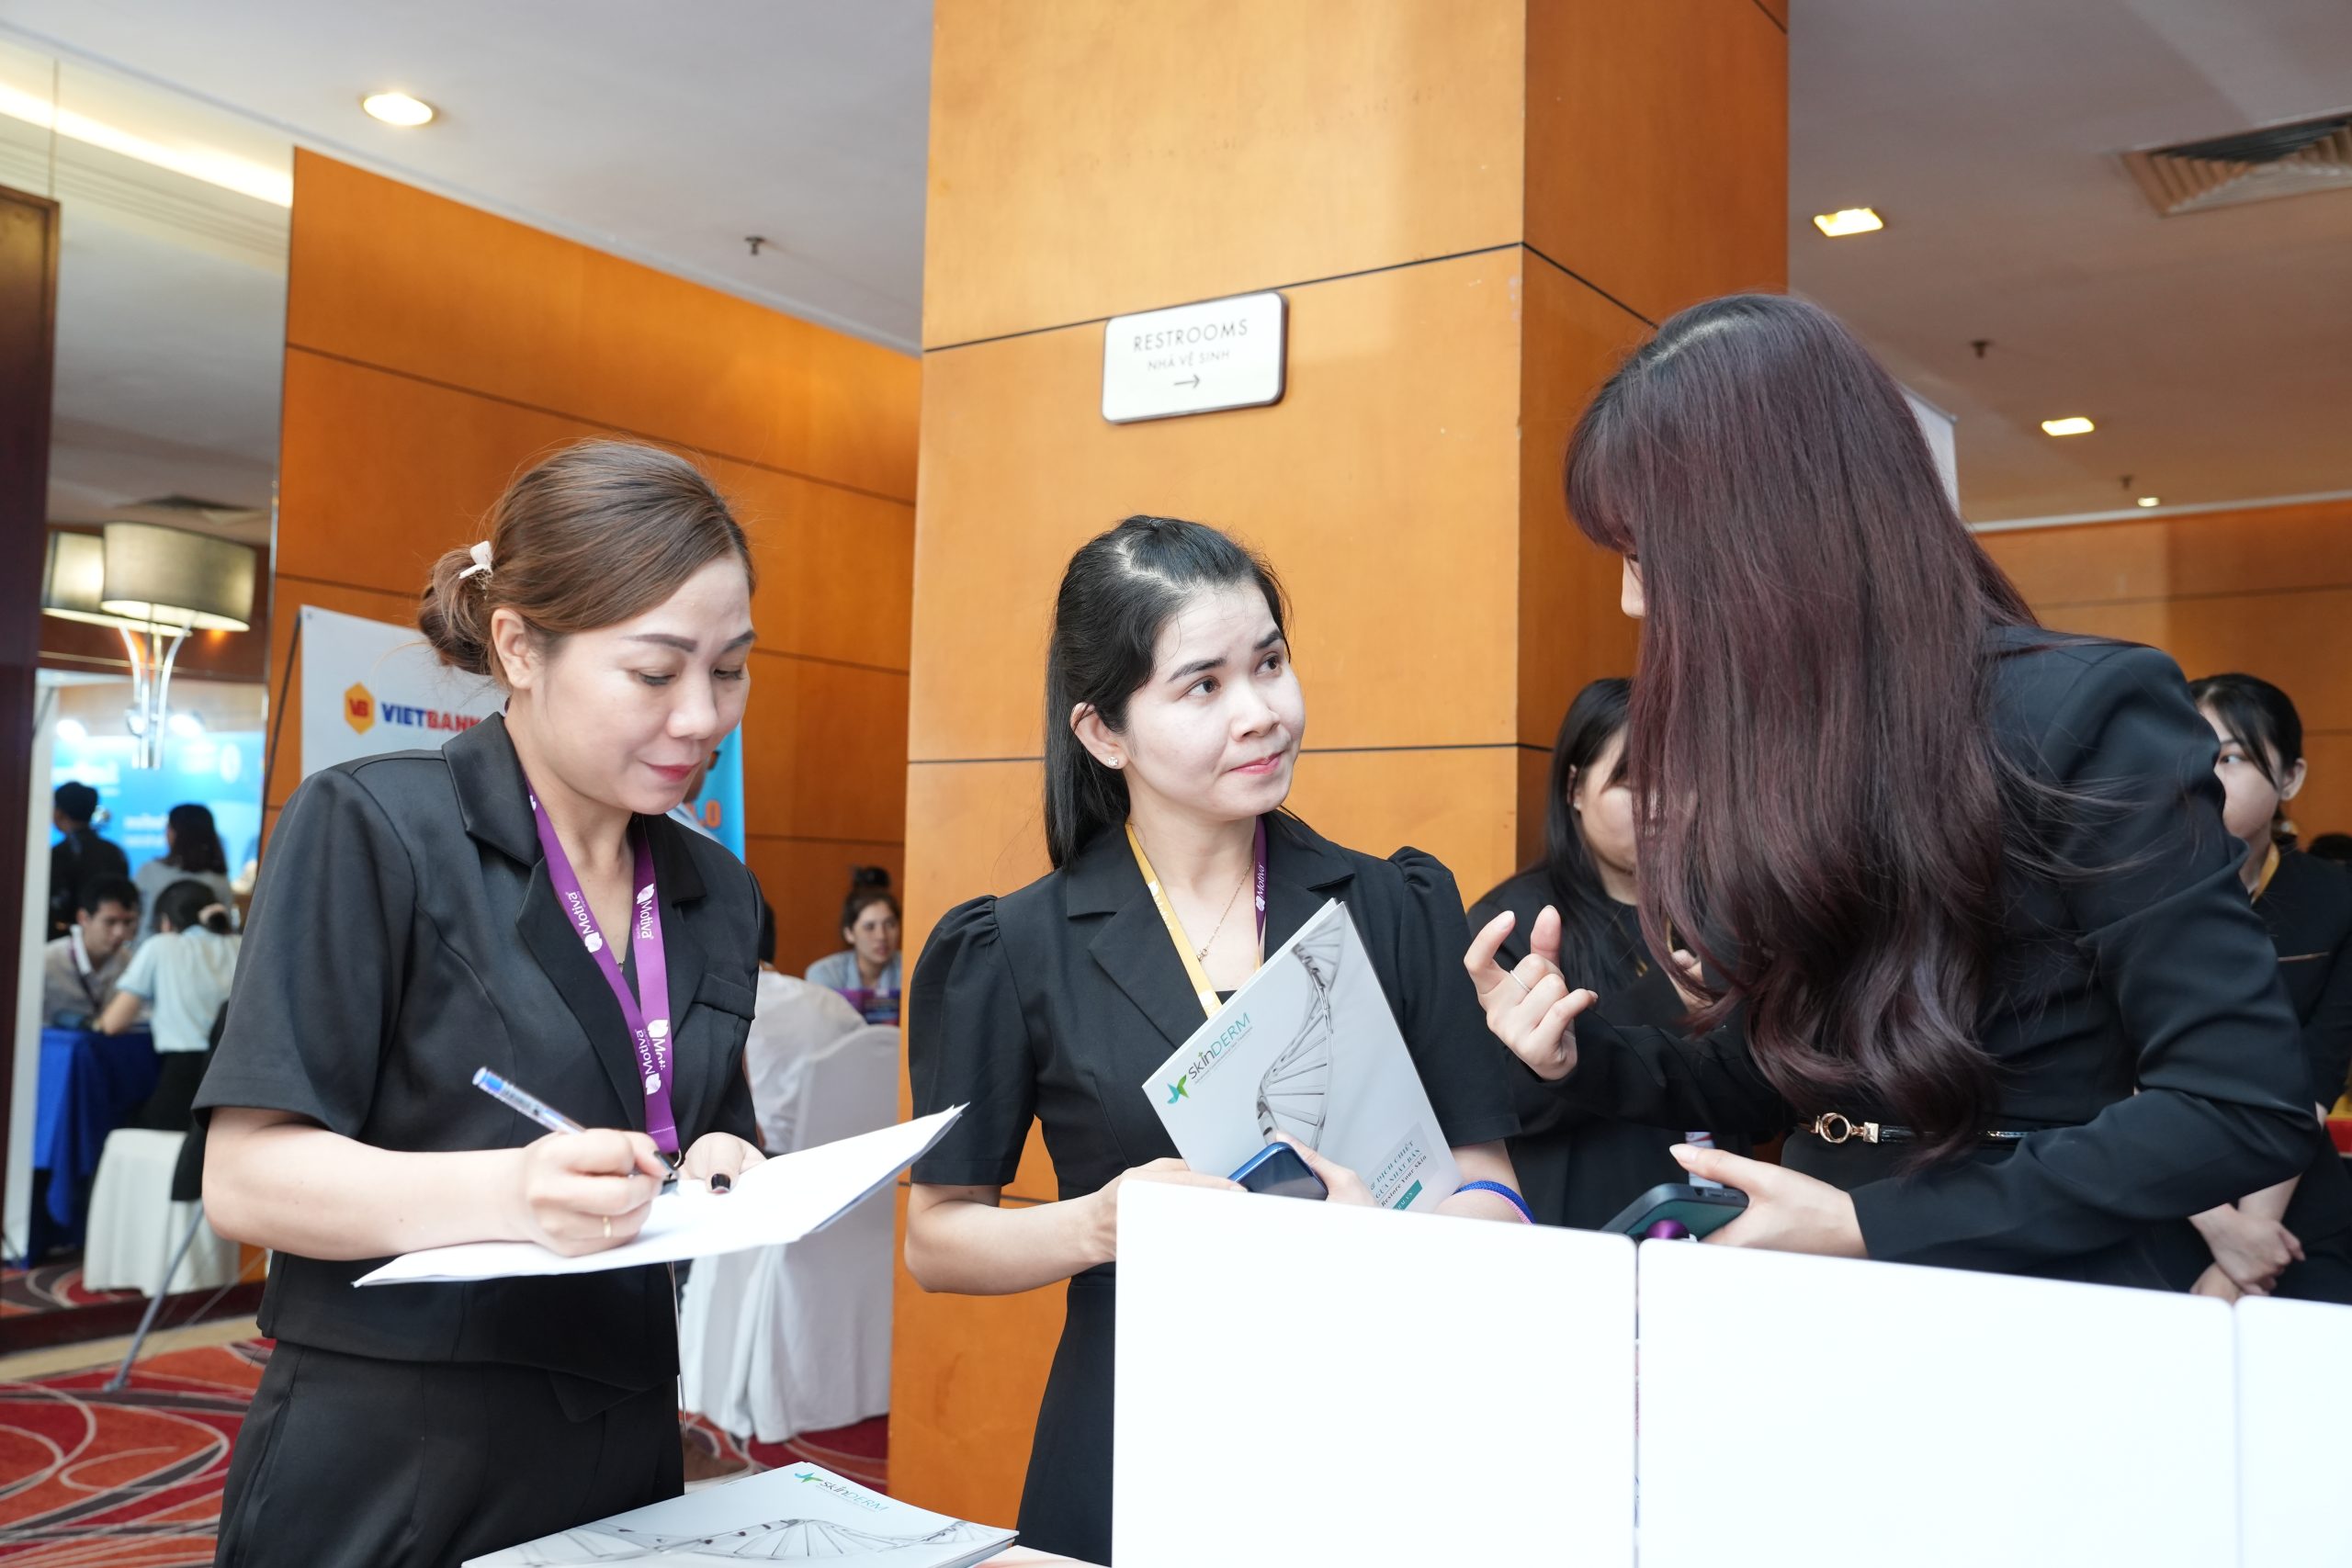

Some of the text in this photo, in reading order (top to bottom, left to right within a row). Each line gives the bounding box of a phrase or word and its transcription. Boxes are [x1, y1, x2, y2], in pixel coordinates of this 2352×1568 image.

[1133, 319, 1248, 352] RESTROOMS
[1199, 349, 1230, 364] SINH
[568, 891, 594, 935] Motiva
[639, 899, 654, 939] Motiva
[636, 1029, 656, 1075] Motiva
[1381, 1155, 1427, 1207] Restore Your Skin
